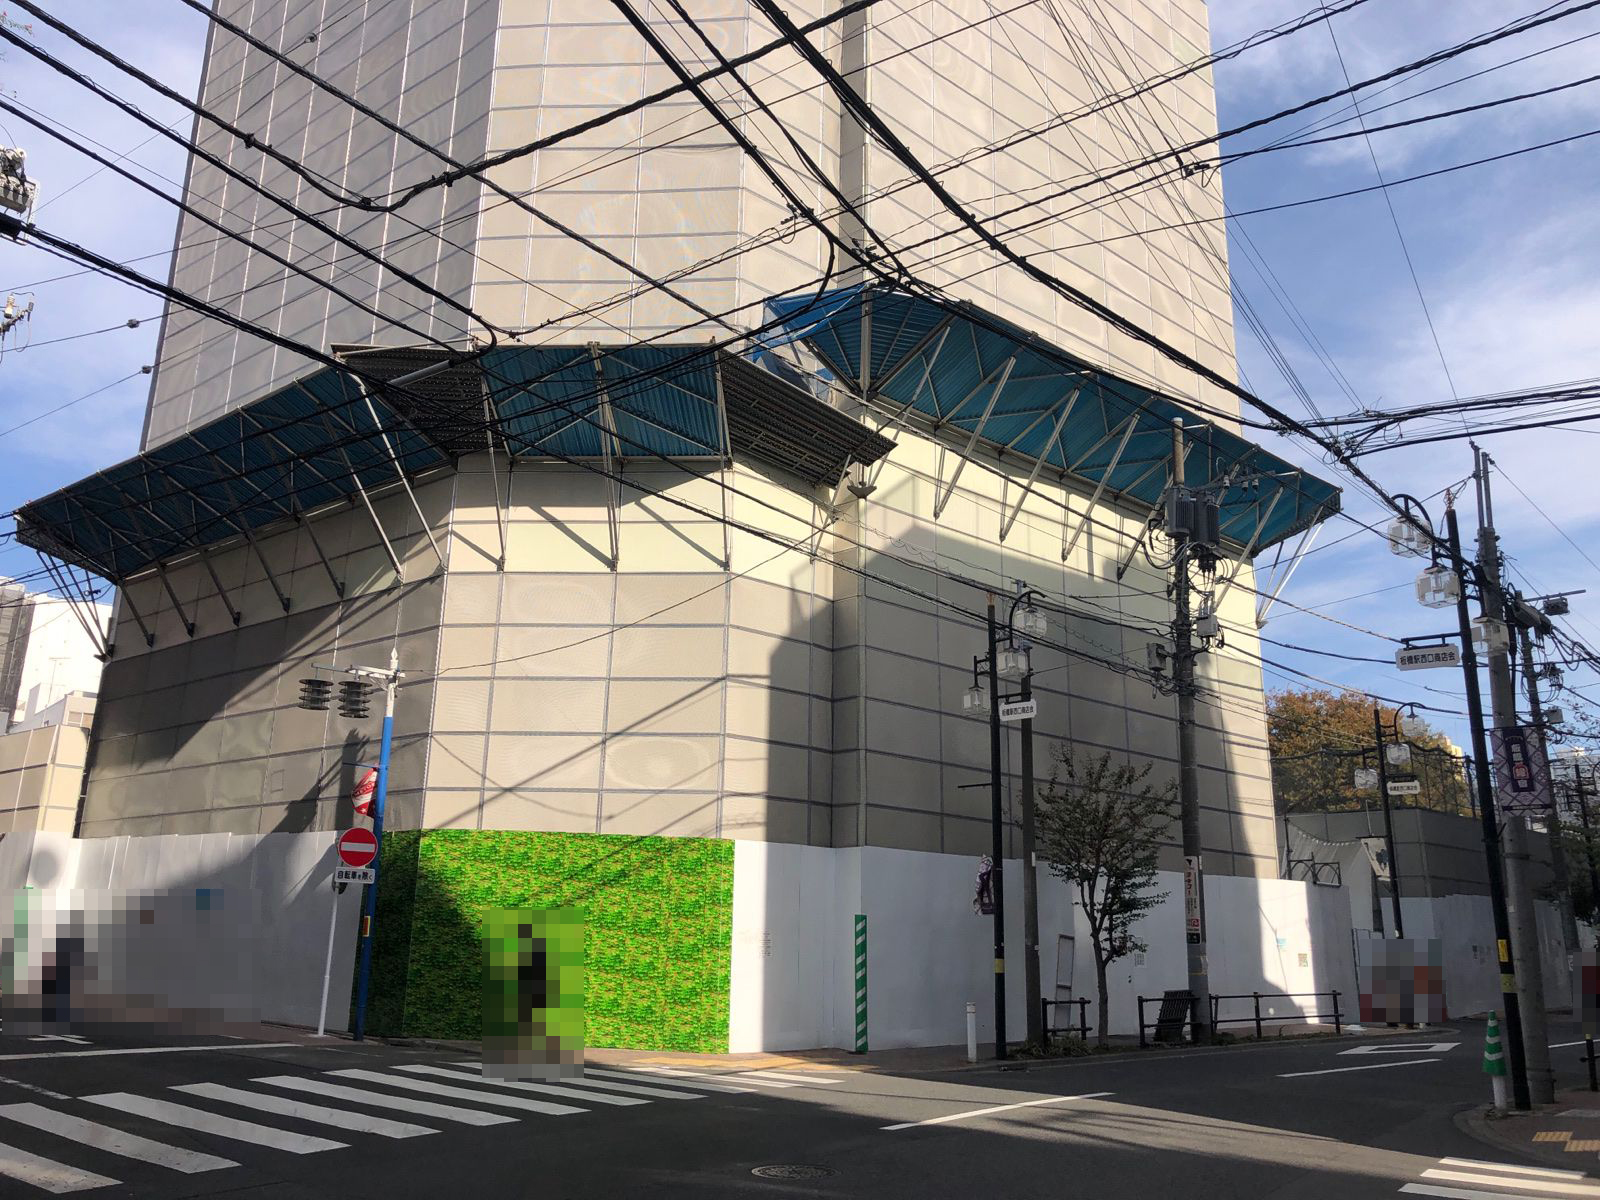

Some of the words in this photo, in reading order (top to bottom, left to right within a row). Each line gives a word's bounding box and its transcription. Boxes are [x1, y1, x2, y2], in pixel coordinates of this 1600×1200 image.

[1400, 651, 1456, 665] 板橋駅西口商店会
[338, 870, 373, 881] 自転車を除く
